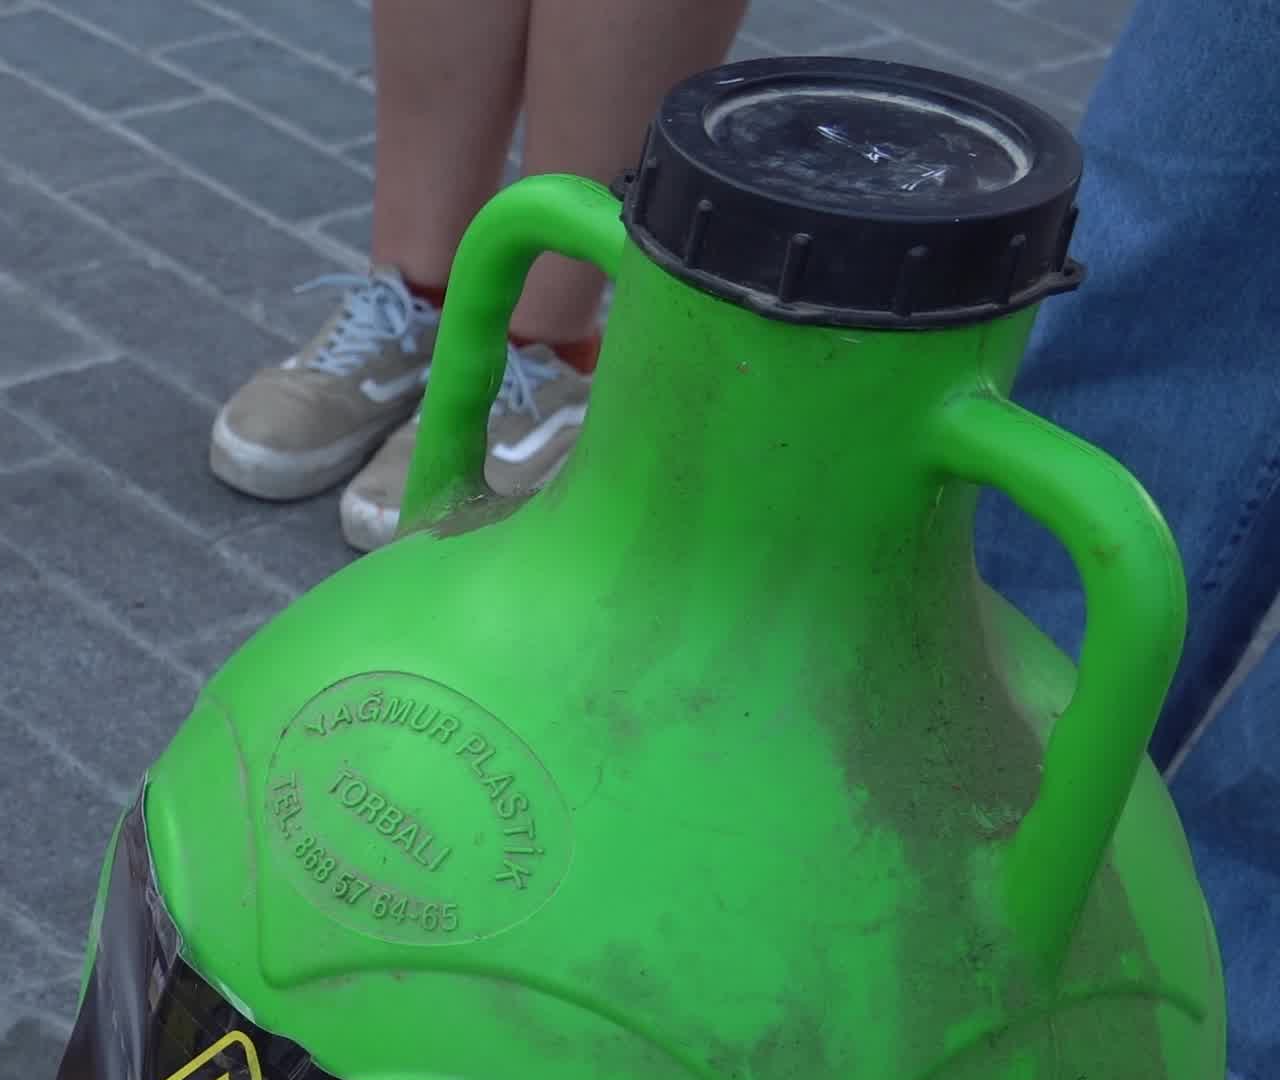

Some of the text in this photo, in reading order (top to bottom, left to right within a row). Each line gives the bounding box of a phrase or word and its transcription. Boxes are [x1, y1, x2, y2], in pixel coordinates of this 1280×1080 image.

[305, 689, 545, 891] YAĞMUR PLASTİK
[328, 769, 453, 872] TORBALI
[295, 836, 336, 883] 868
[333, 872, 372, 904] 57
[372, 892, 460, 933] 64-65
